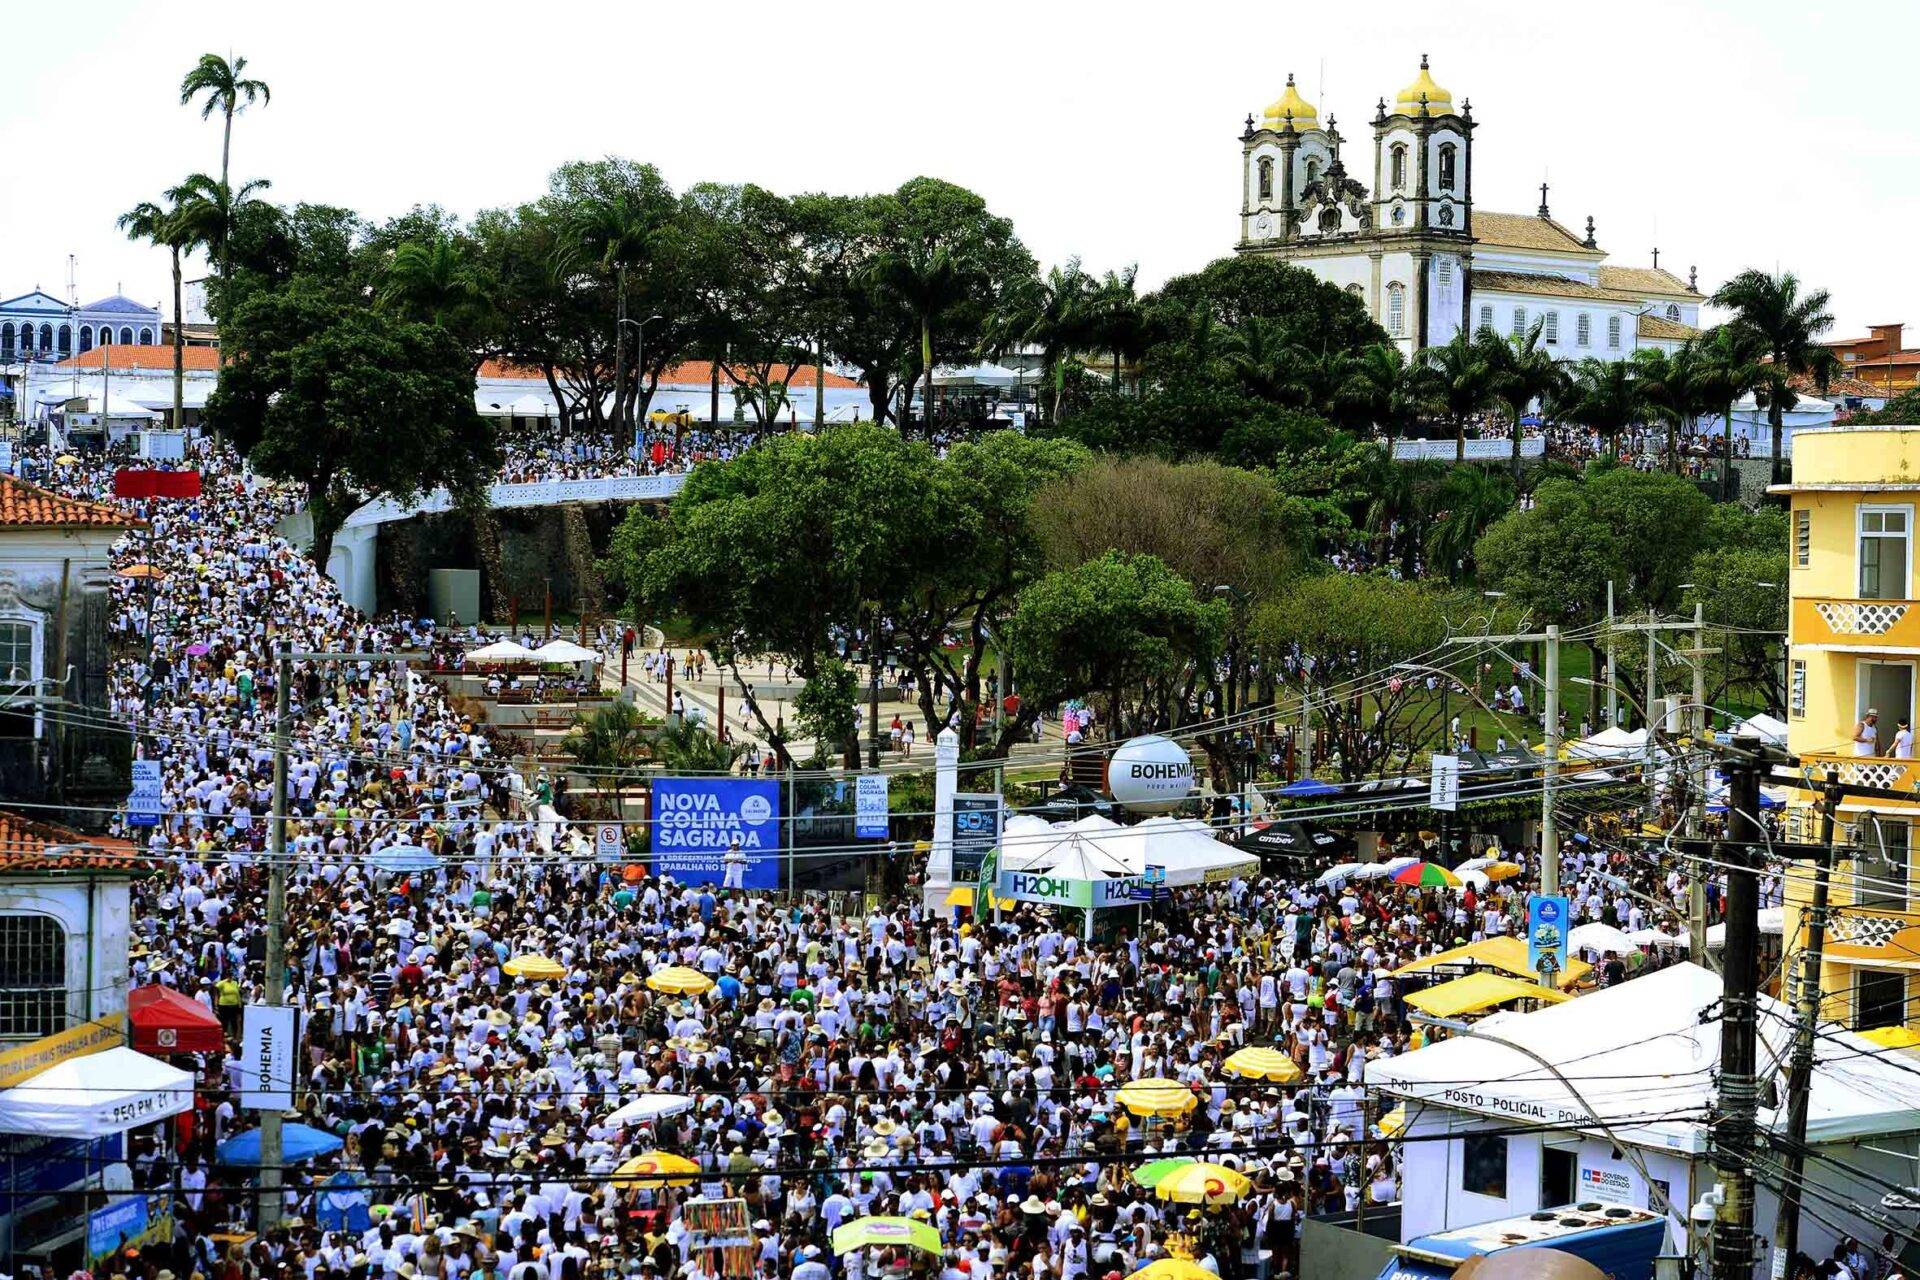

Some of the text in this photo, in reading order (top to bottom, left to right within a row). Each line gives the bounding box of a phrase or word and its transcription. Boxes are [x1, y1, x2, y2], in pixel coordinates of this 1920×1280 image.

[660, 793, 720, 811] NOVA
[660, 811, 741, 829] COLINA
[659, 829, 761, 848] SAGRADA
[1259, 835, 1295, 844] ambev
[659, 862, 704, 871] TRABALHA
[706, 862, 720, 871] NO
[1013, 874, 1070, 898] H2OH!
[260, 1026, 272, 1093] BOHEMIA
[1445, 1089, 1484, 1107] POSTO
[1493, 1098, 1547, 1118] POLICIAL
[1602, 1172, 1629, 1183] GOVERNO
[1609, 1179, 1630, 1189] ESTADO
